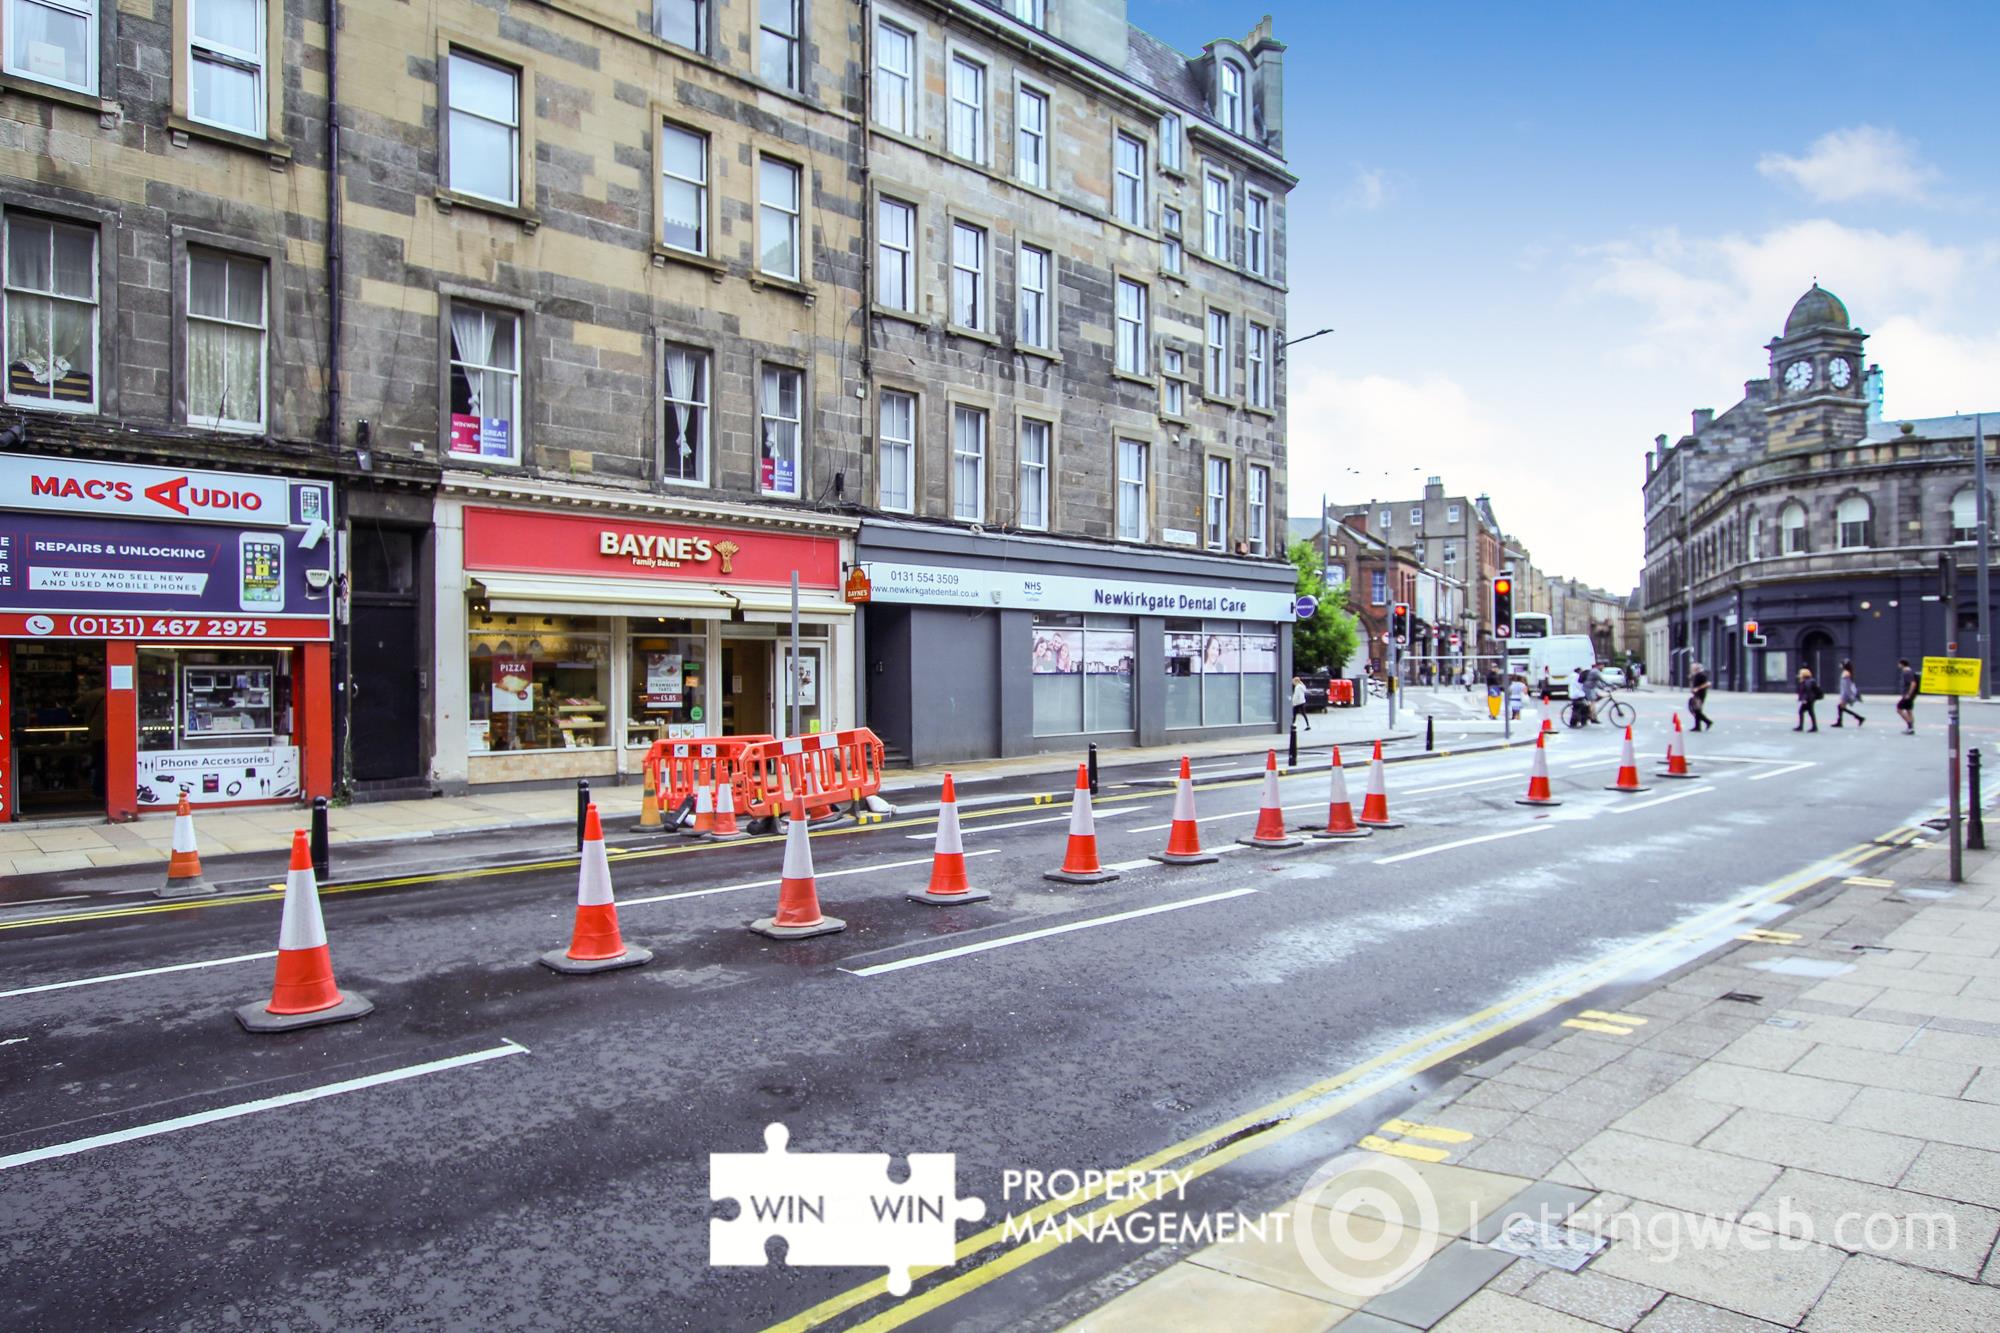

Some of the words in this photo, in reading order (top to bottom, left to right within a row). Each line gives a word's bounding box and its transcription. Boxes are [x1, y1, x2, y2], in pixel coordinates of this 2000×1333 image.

[31, 475, 133, 501] MAC'S
[144, 476, 262, 516] AUDIO
[35, 541, 102, 554] REPAIRS
[105, 544, 116, 555] &
[119, 546, 206, 559] UNLOCKING
[600, 531, 712, 561] BAYNE'S
[632, 557, 656, 569] Family
[657, 558, 681, 568] Bakers
[52, 570, 69, 578] WE
[74, 571, 96, 579] BUY
[101, 572, 125, 580] AND
[130, 573, 155, 582] SELL
[160, 574, 184, 582] NEW
[890, 570, 914, 582] 0131
[917, 572, 934, 583] 554
[936, 574, 959, 585] 3509
[41, 579, 66, 587] AND
[71, 580, 101, 588] USED
[106, 581, 149, 590] MOBILE
[153, 583, 198, 592] PHONES
[1024, 581, 1042, 591] NHS
[1094, 588, 1175, 612] Newkirkgate
[1179, 594, 1217, 611] Dental
[1220, 597, 1247, 613] Care
[69, 615, 145, 637] (0131)
[152, 618, 200, 636] 467
[207, 619, 267, 636] 2975
[499, 663, 526, 672] PIZZA
[160, 758, 199, 768] Phone
[201, 755, 270, 767] Accessories
